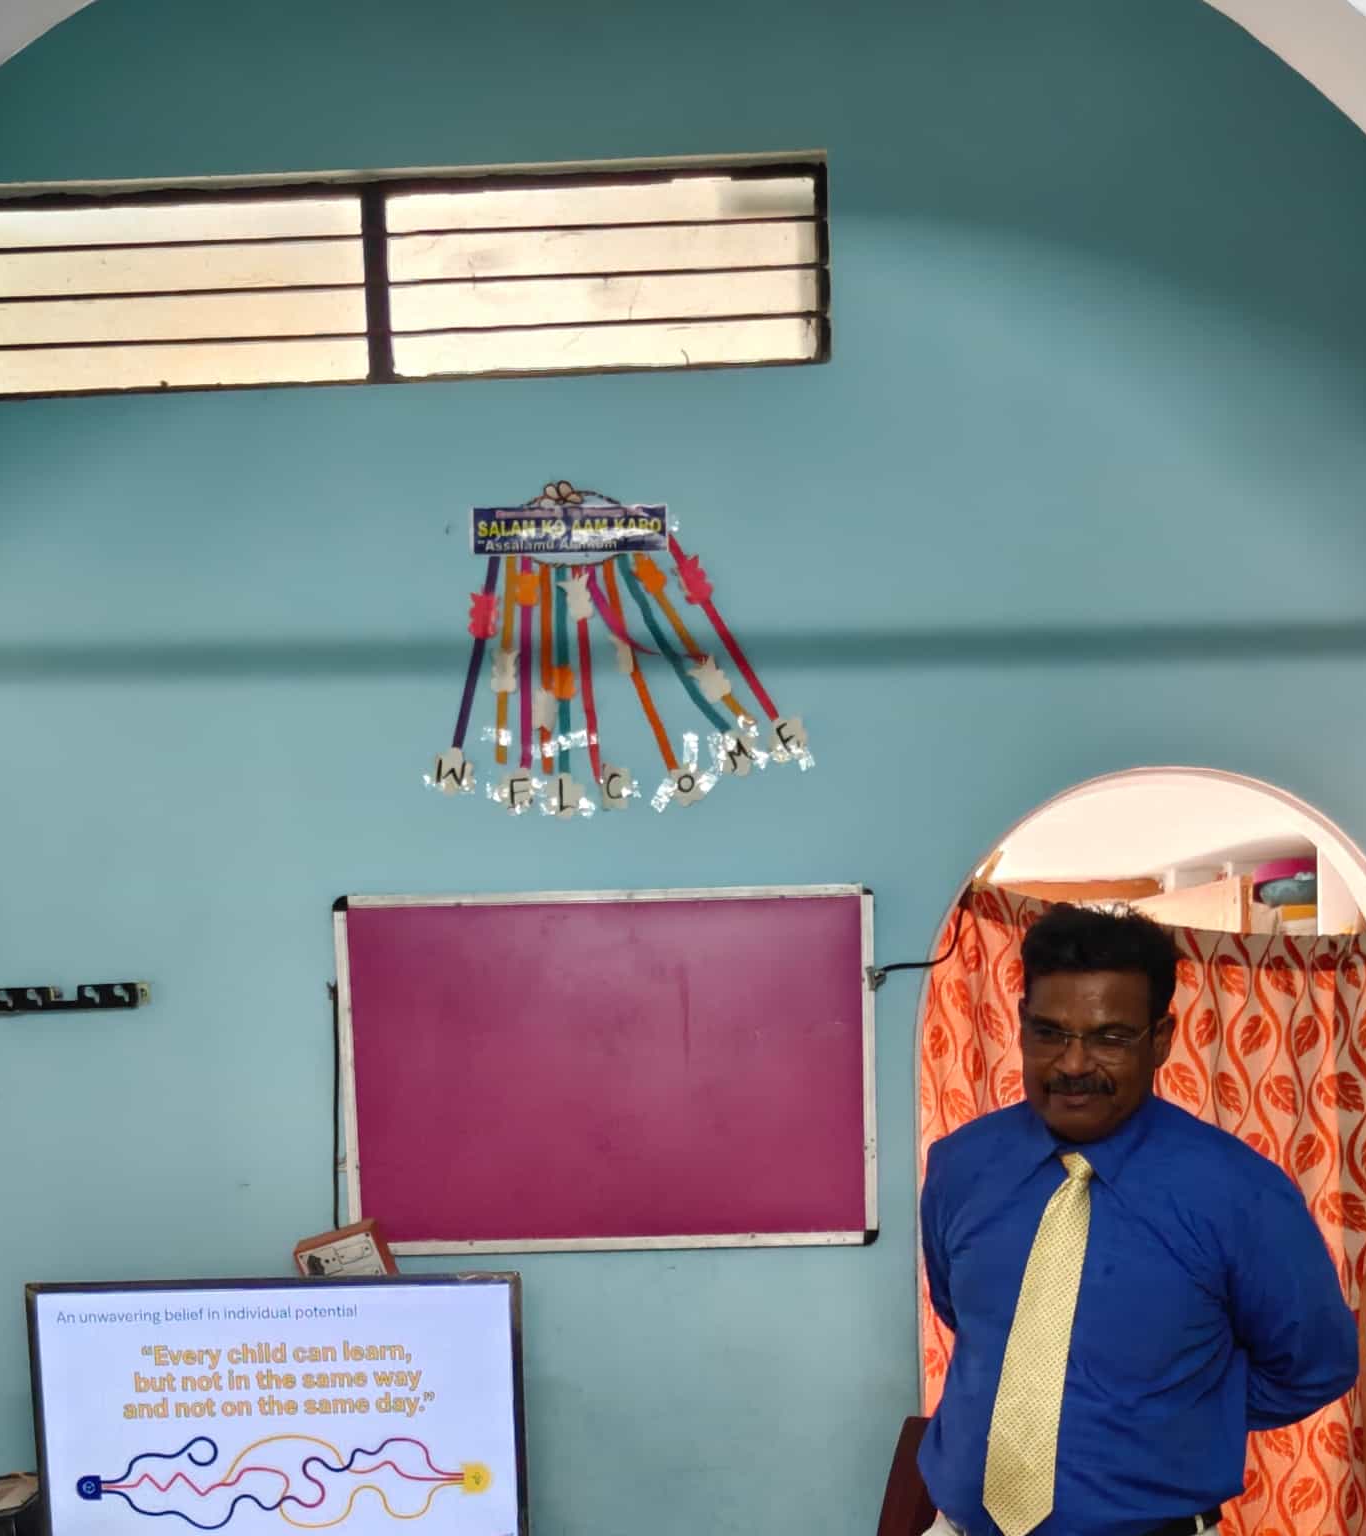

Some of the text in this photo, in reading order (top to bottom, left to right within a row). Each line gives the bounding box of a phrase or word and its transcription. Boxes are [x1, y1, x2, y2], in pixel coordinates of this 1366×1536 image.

[477, 520, 536, 538] SALAM
[56, 1304, 357, 1325] An unwavering belief in individual potential
[227, 1342, 287, 1364] child
[293, 1346, 337, 1363] can
[342, 1340, 412, 1364] learn,
[134, 1369, 422, 1393] but not in the same way
[123, 1397, 169, 1420] and
[175, 1398, 216, 1418] not
[221, 1399, 252, 1416] on
[258, 1395, 298, 1416] the
[304, 1397, 370, 1414] same
